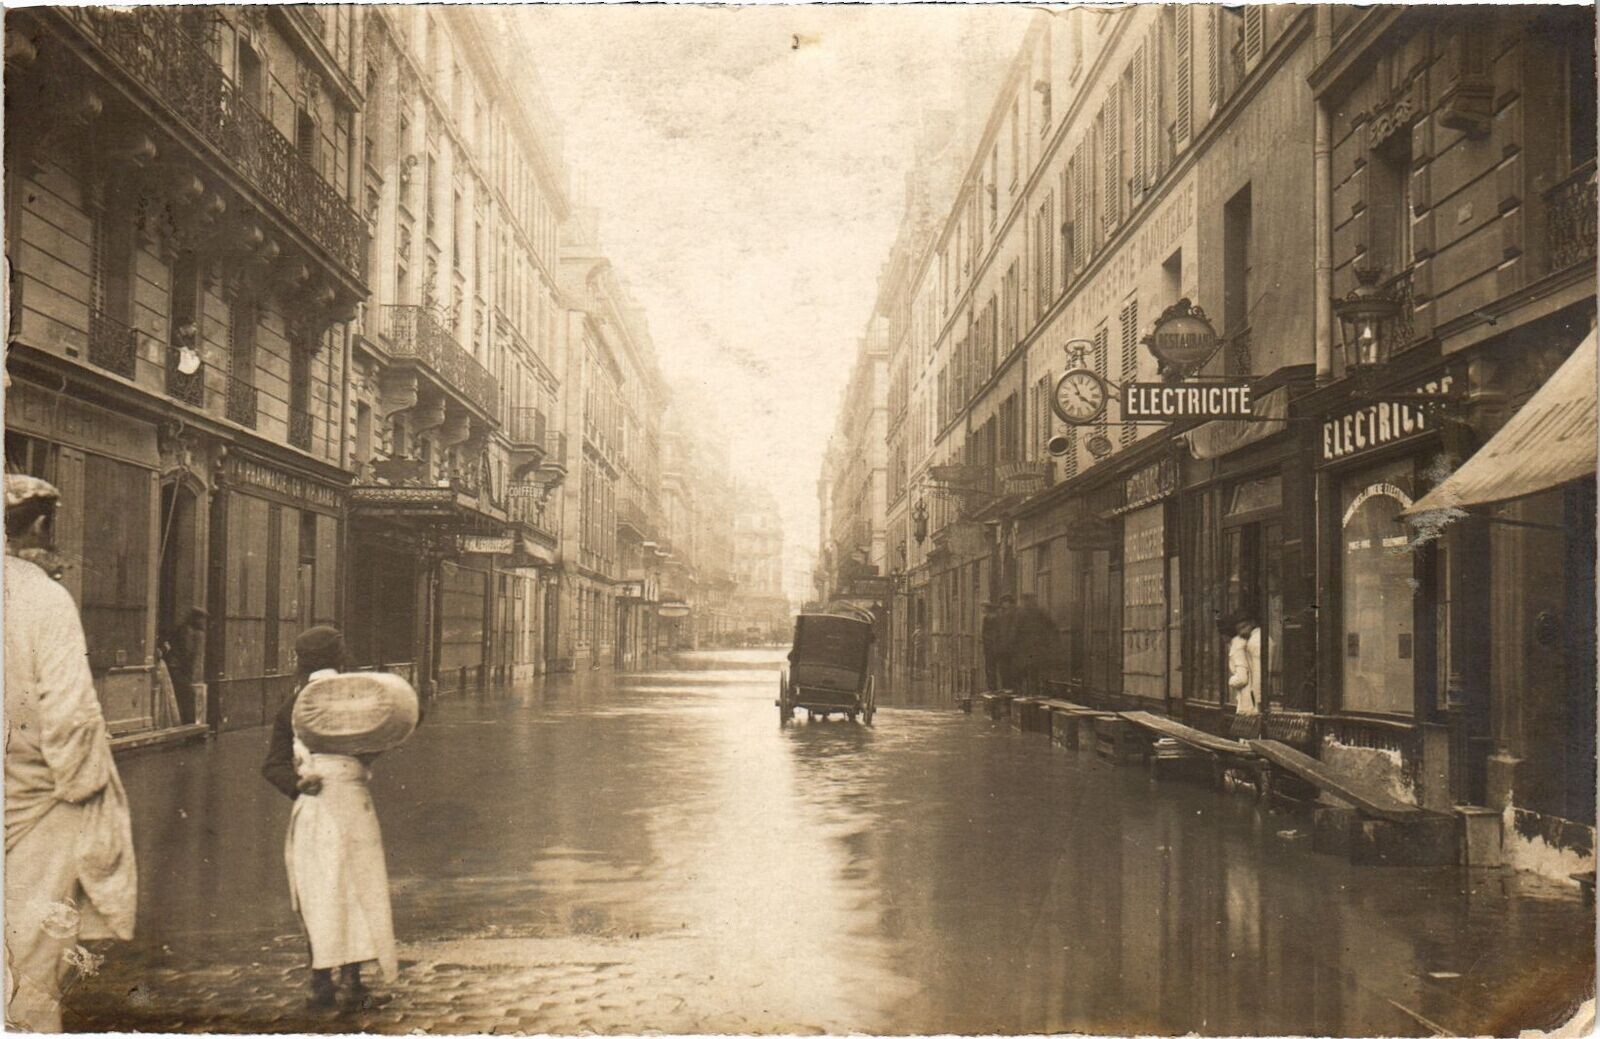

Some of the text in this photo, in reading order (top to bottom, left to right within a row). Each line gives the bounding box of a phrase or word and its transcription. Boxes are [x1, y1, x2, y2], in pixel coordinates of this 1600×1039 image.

[1158, 333, 1214, 349] RESTAURANT
[1127, 384, 1251, 415] ÉLECTRICITÉ
[508, 486, 543, 497] COIFFEUR
